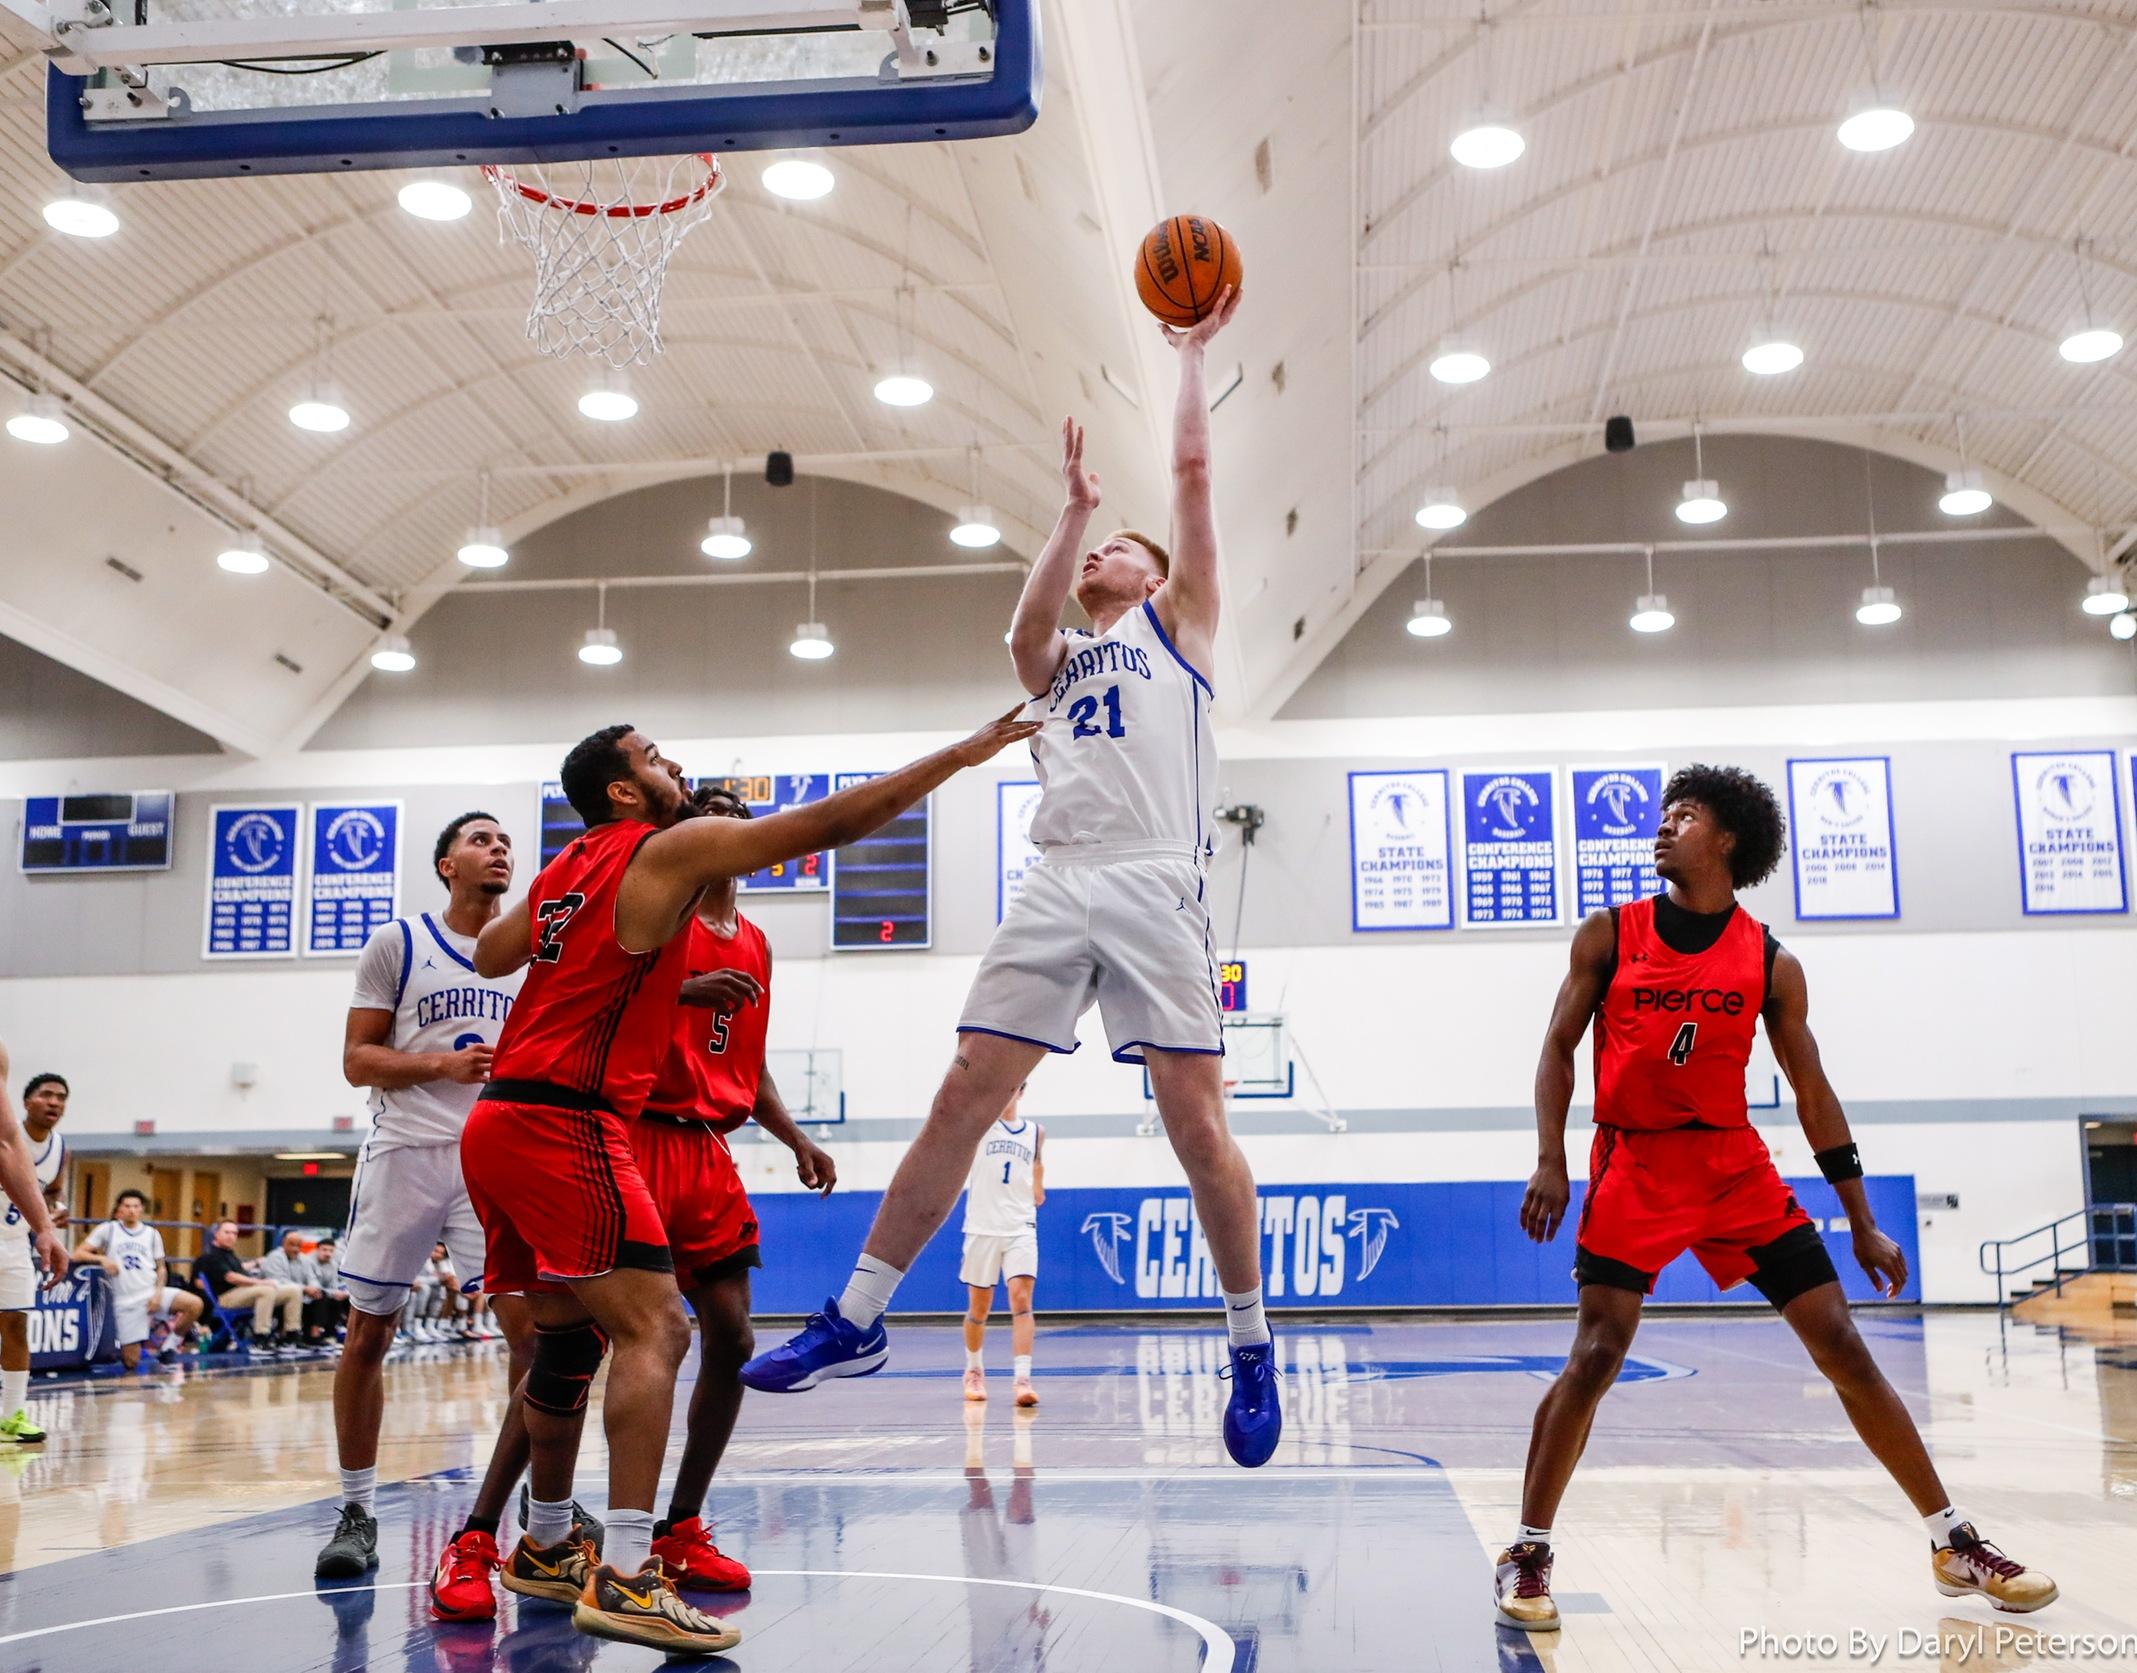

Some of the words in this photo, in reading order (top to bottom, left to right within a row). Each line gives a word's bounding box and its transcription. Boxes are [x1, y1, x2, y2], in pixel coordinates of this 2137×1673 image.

[1067, 684, 1126, 741] 21
[1602, 824, 1637, 836] BASEBALL
[2046, 828, 2094, 839] STATE
[1578, 837, 1656, 852] CONFERENC
[1820, 833, 1867, 845] STATE
[1378, 847, 1424, 858] STATE
[1467, 841, 1553, 855] CONFERENCE
[1802, 847, 1887, 859] CHAMPIONS
[2029, 842, 2114, 853] CHAMPIONS
[804, 855, 819, 876] 2
[1361, 860, 1444, 872] CHAMPIONS
[1468, 855, 1554, 870] CHAMPIONS
[1579, 851, 1655, 866] CHAMPION
[1611, 867, 1632, 879] 1977
[1640, 867, 1657, 878] 197
[880, 921, 895, 942] 2
[417, 987, 515, 1027] CERRITO
[709, 1011, 733, 1055] 5
[1667, 1022, 1698, 1067] 4
[1002, 1161, 1011, 1184] 1
[1136, 1195, 1346, 1298] CERTOS
[26, 1308, 80, 1353] ONS
